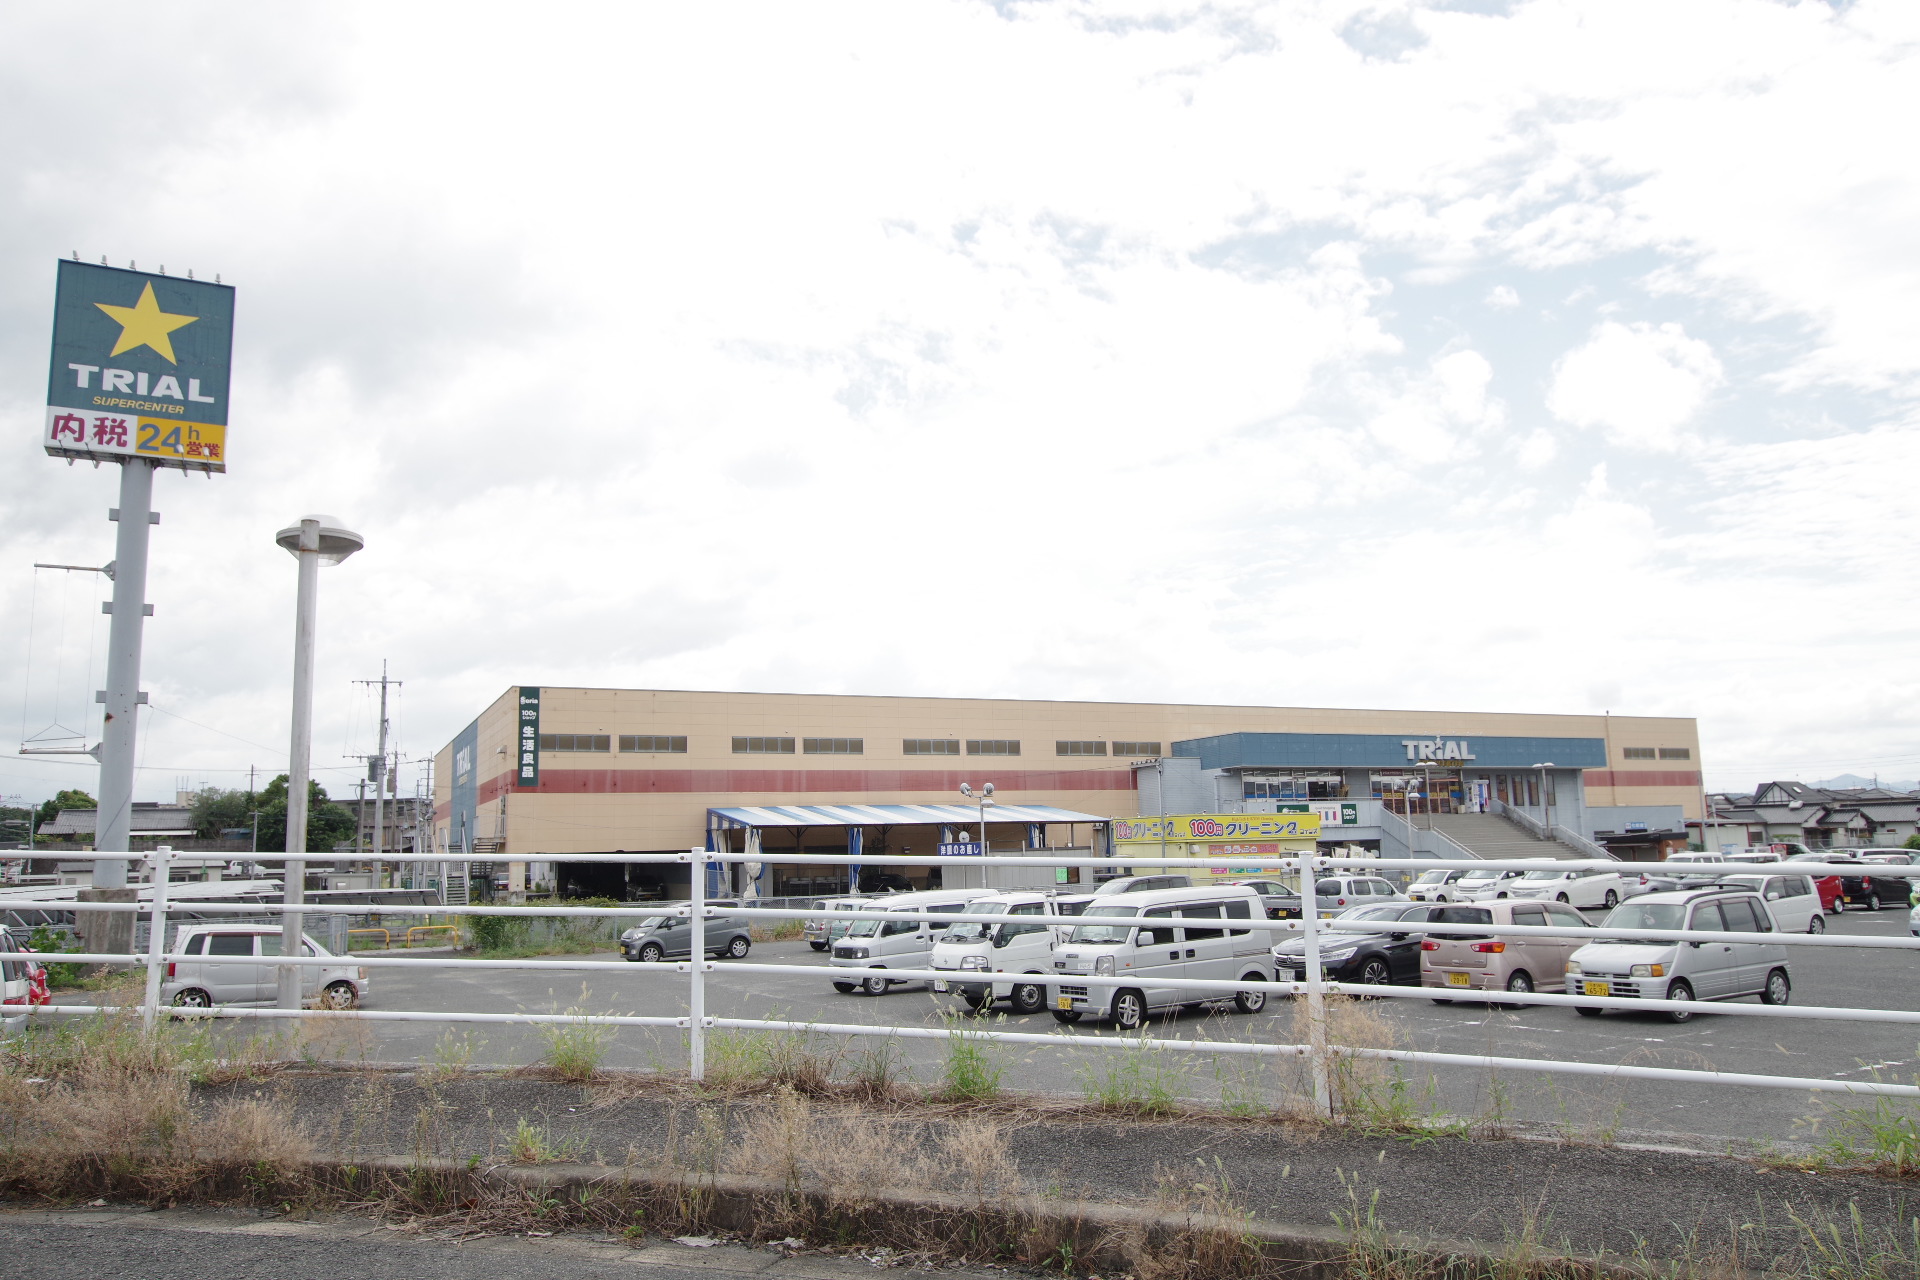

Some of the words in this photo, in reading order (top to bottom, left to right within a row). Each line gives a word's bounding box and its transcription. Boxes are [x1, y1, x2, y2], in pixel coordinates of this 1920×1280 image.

[68, 363, 215, 403] TRIAL
[92, 396, 185, 414] SUPERCENTER
[51, 413, 128, 448] 内税
[522, 726, 535, 778] 生活良品
[1401, 738, 1476, 760] TRIAL
[940, 844, 979, 856] 洋服のお直し
